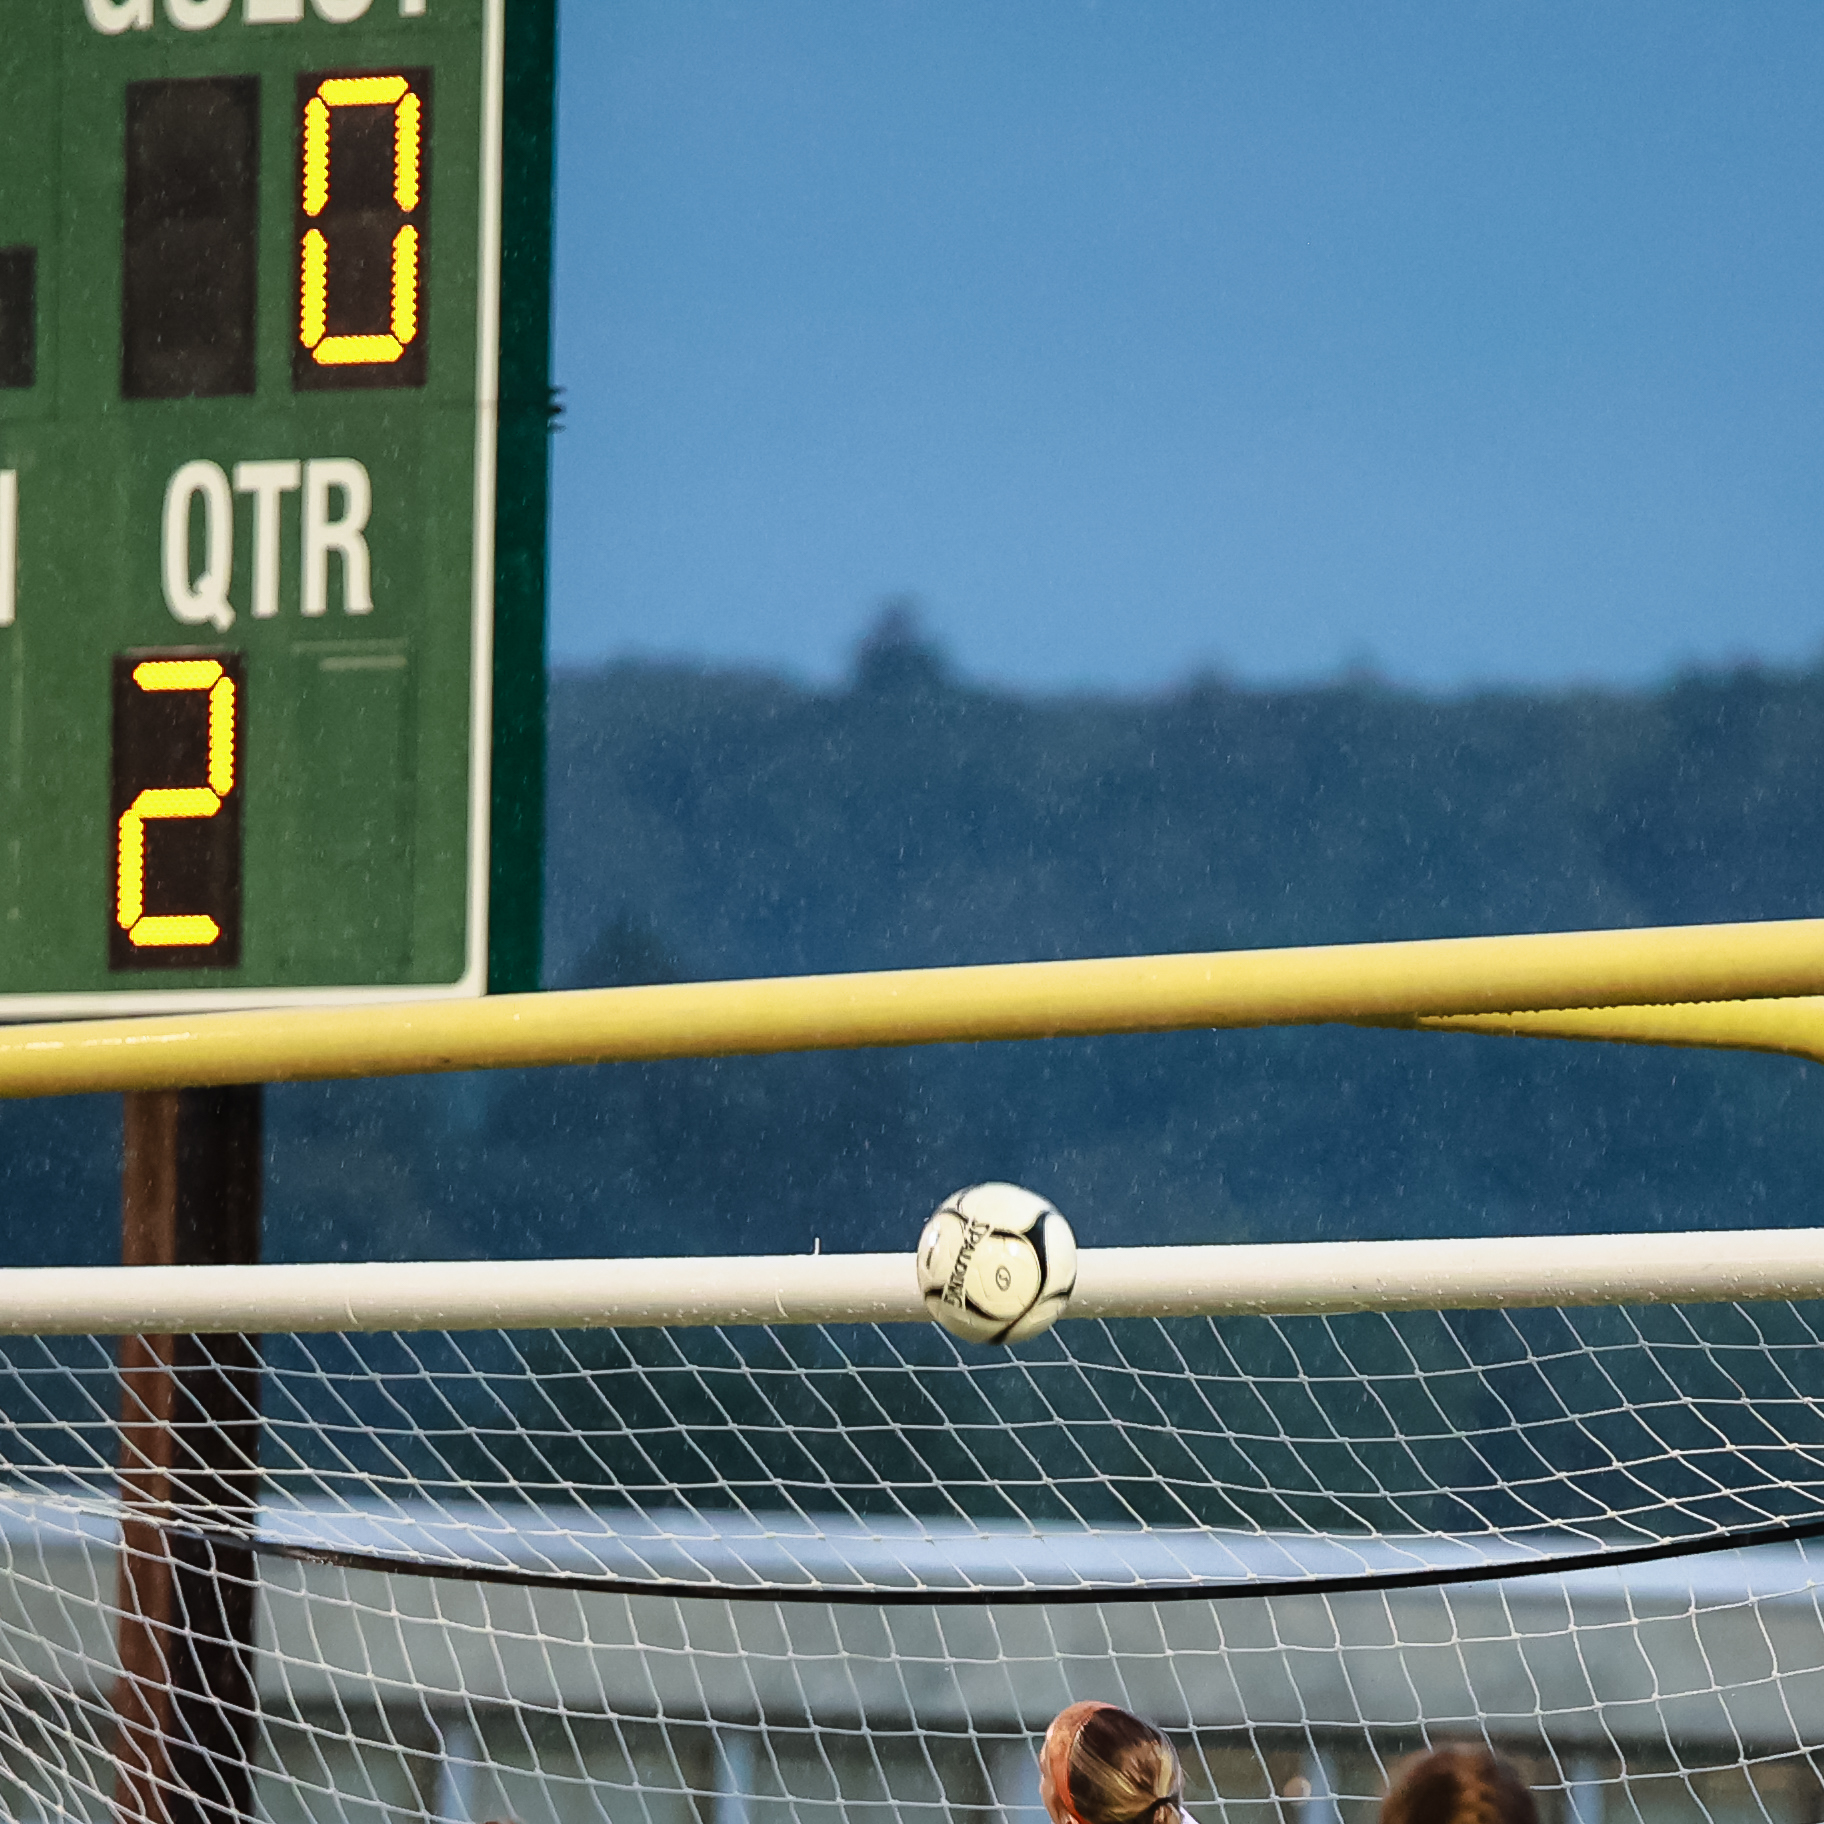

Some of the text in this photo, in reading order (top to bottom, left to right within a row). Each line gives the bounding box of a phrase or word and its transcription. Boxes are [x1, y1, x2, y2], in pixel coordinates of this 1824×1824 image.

[299, 75, 421, 365] 0
[161, 458, 374, 631] QTR
[117, 659, 235, 946] 2
